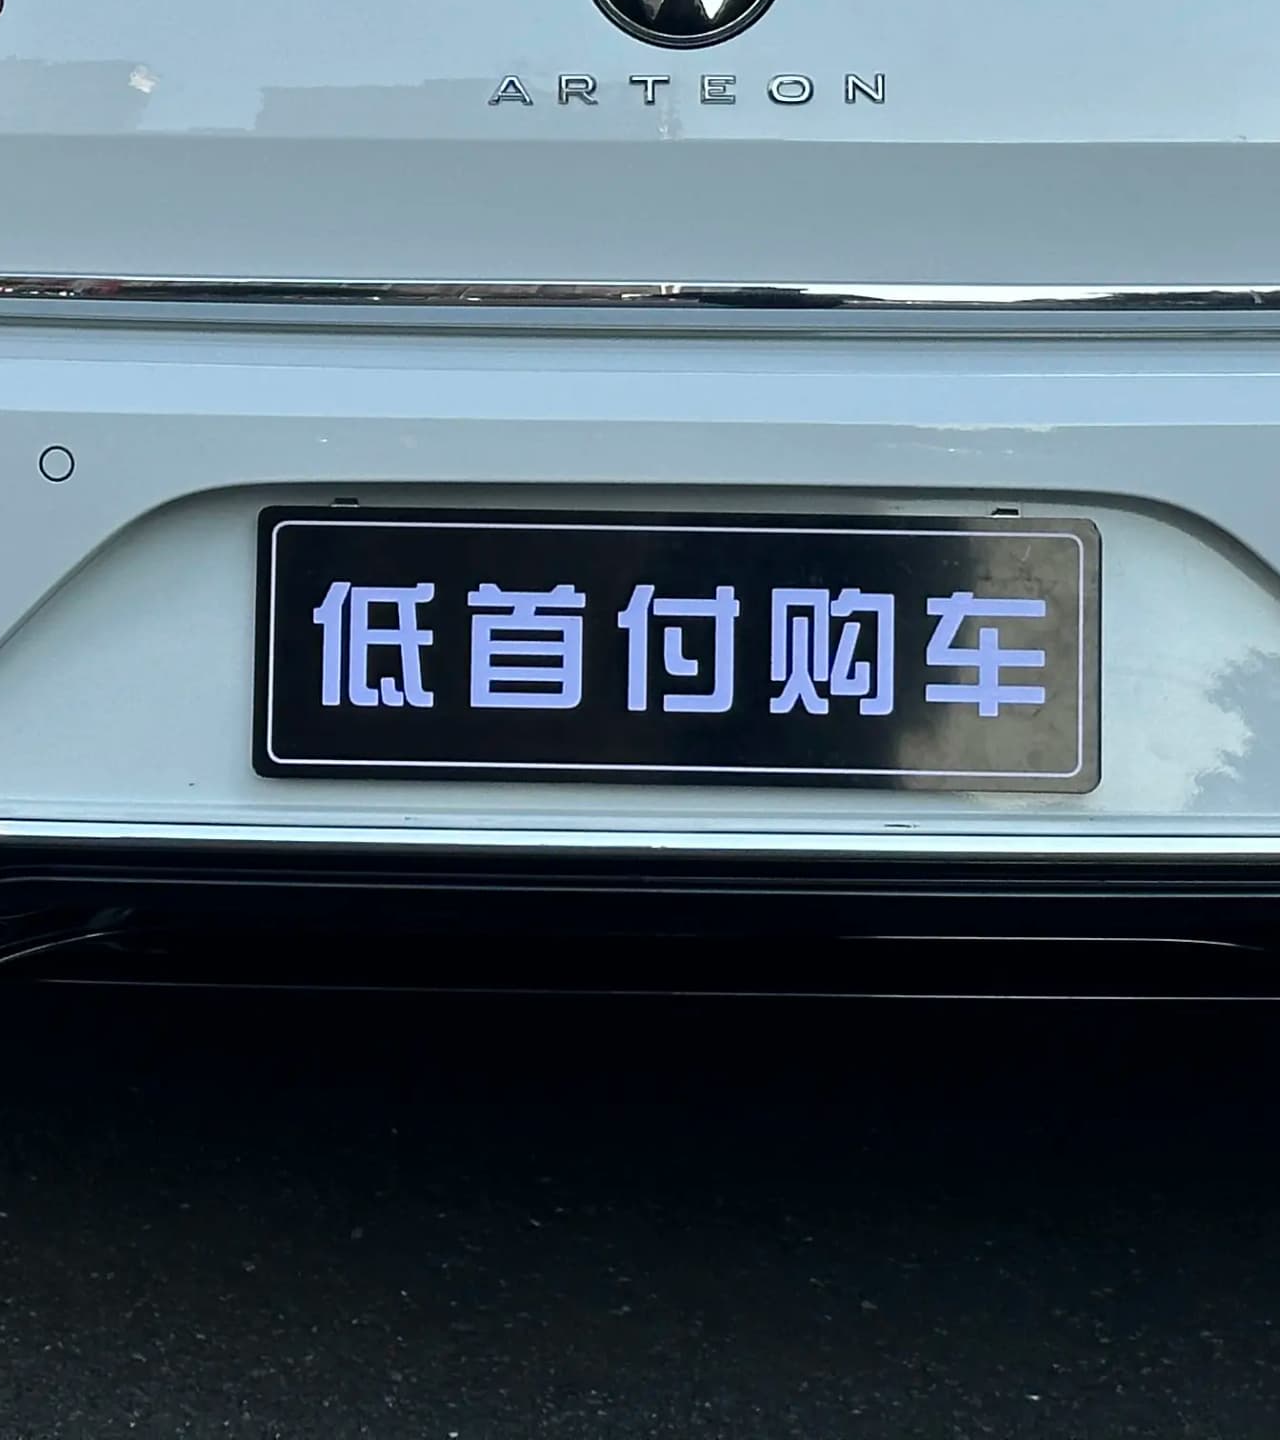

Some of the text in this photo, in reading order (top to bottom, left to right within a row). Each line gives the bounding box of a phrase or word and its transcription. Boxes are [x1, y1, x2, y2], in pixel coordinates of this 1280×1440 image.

[488, 73, 887, 106] ARTEON
[313, 580, 1047, 718] 低首付购车
